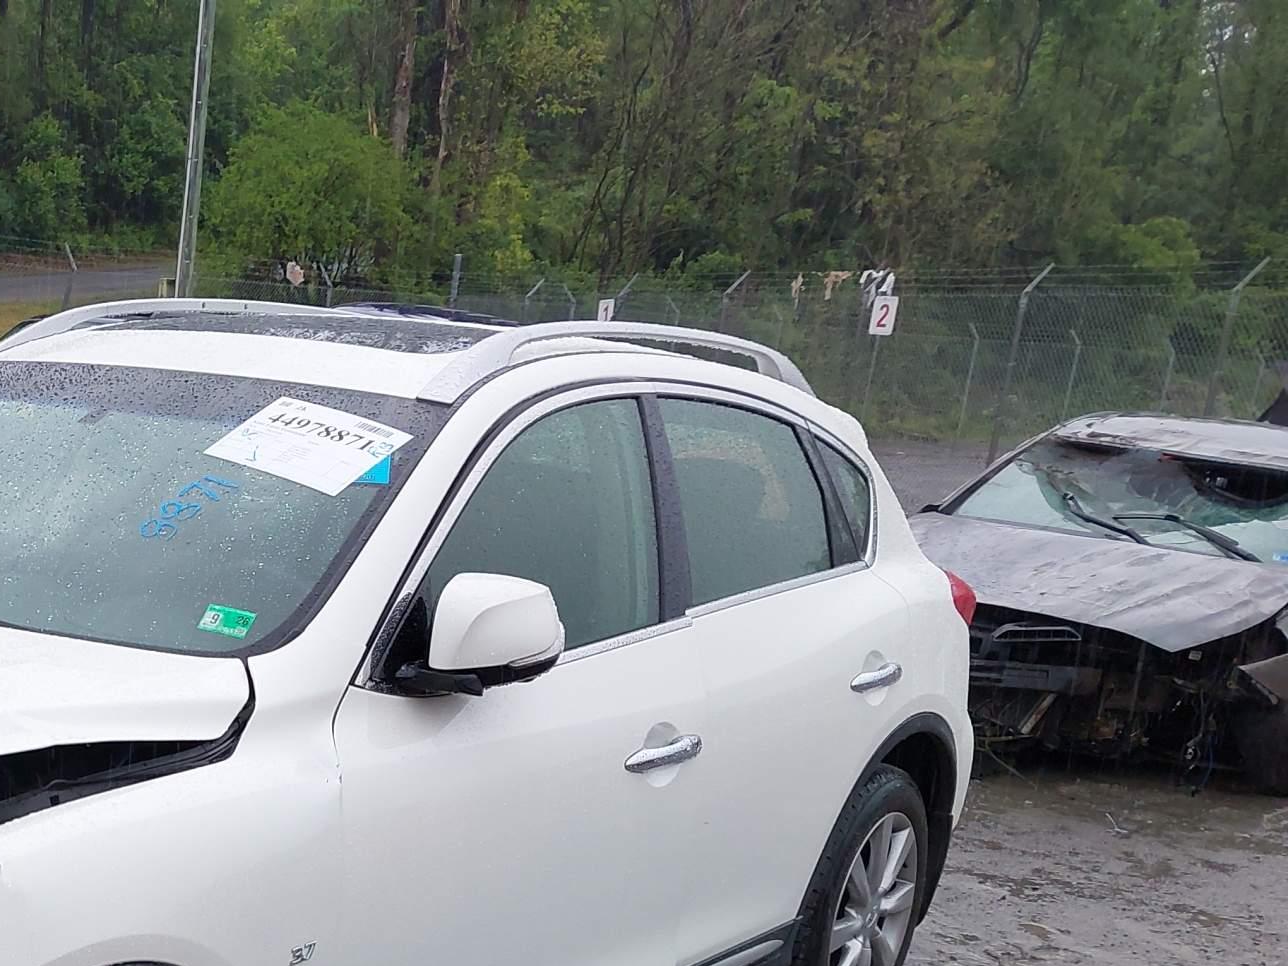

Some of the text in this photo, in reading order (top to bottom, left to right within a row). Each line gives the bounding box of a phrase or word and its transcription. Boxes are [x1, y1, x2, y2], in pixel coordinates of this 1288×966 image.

[603, 304, 610, 321] 1
[876, 304, 890, 328] 2
[268, 412, 376, 451] 44978871
[140, 475, 239, 541] 8871
[210, 613, 220, 625] 9
